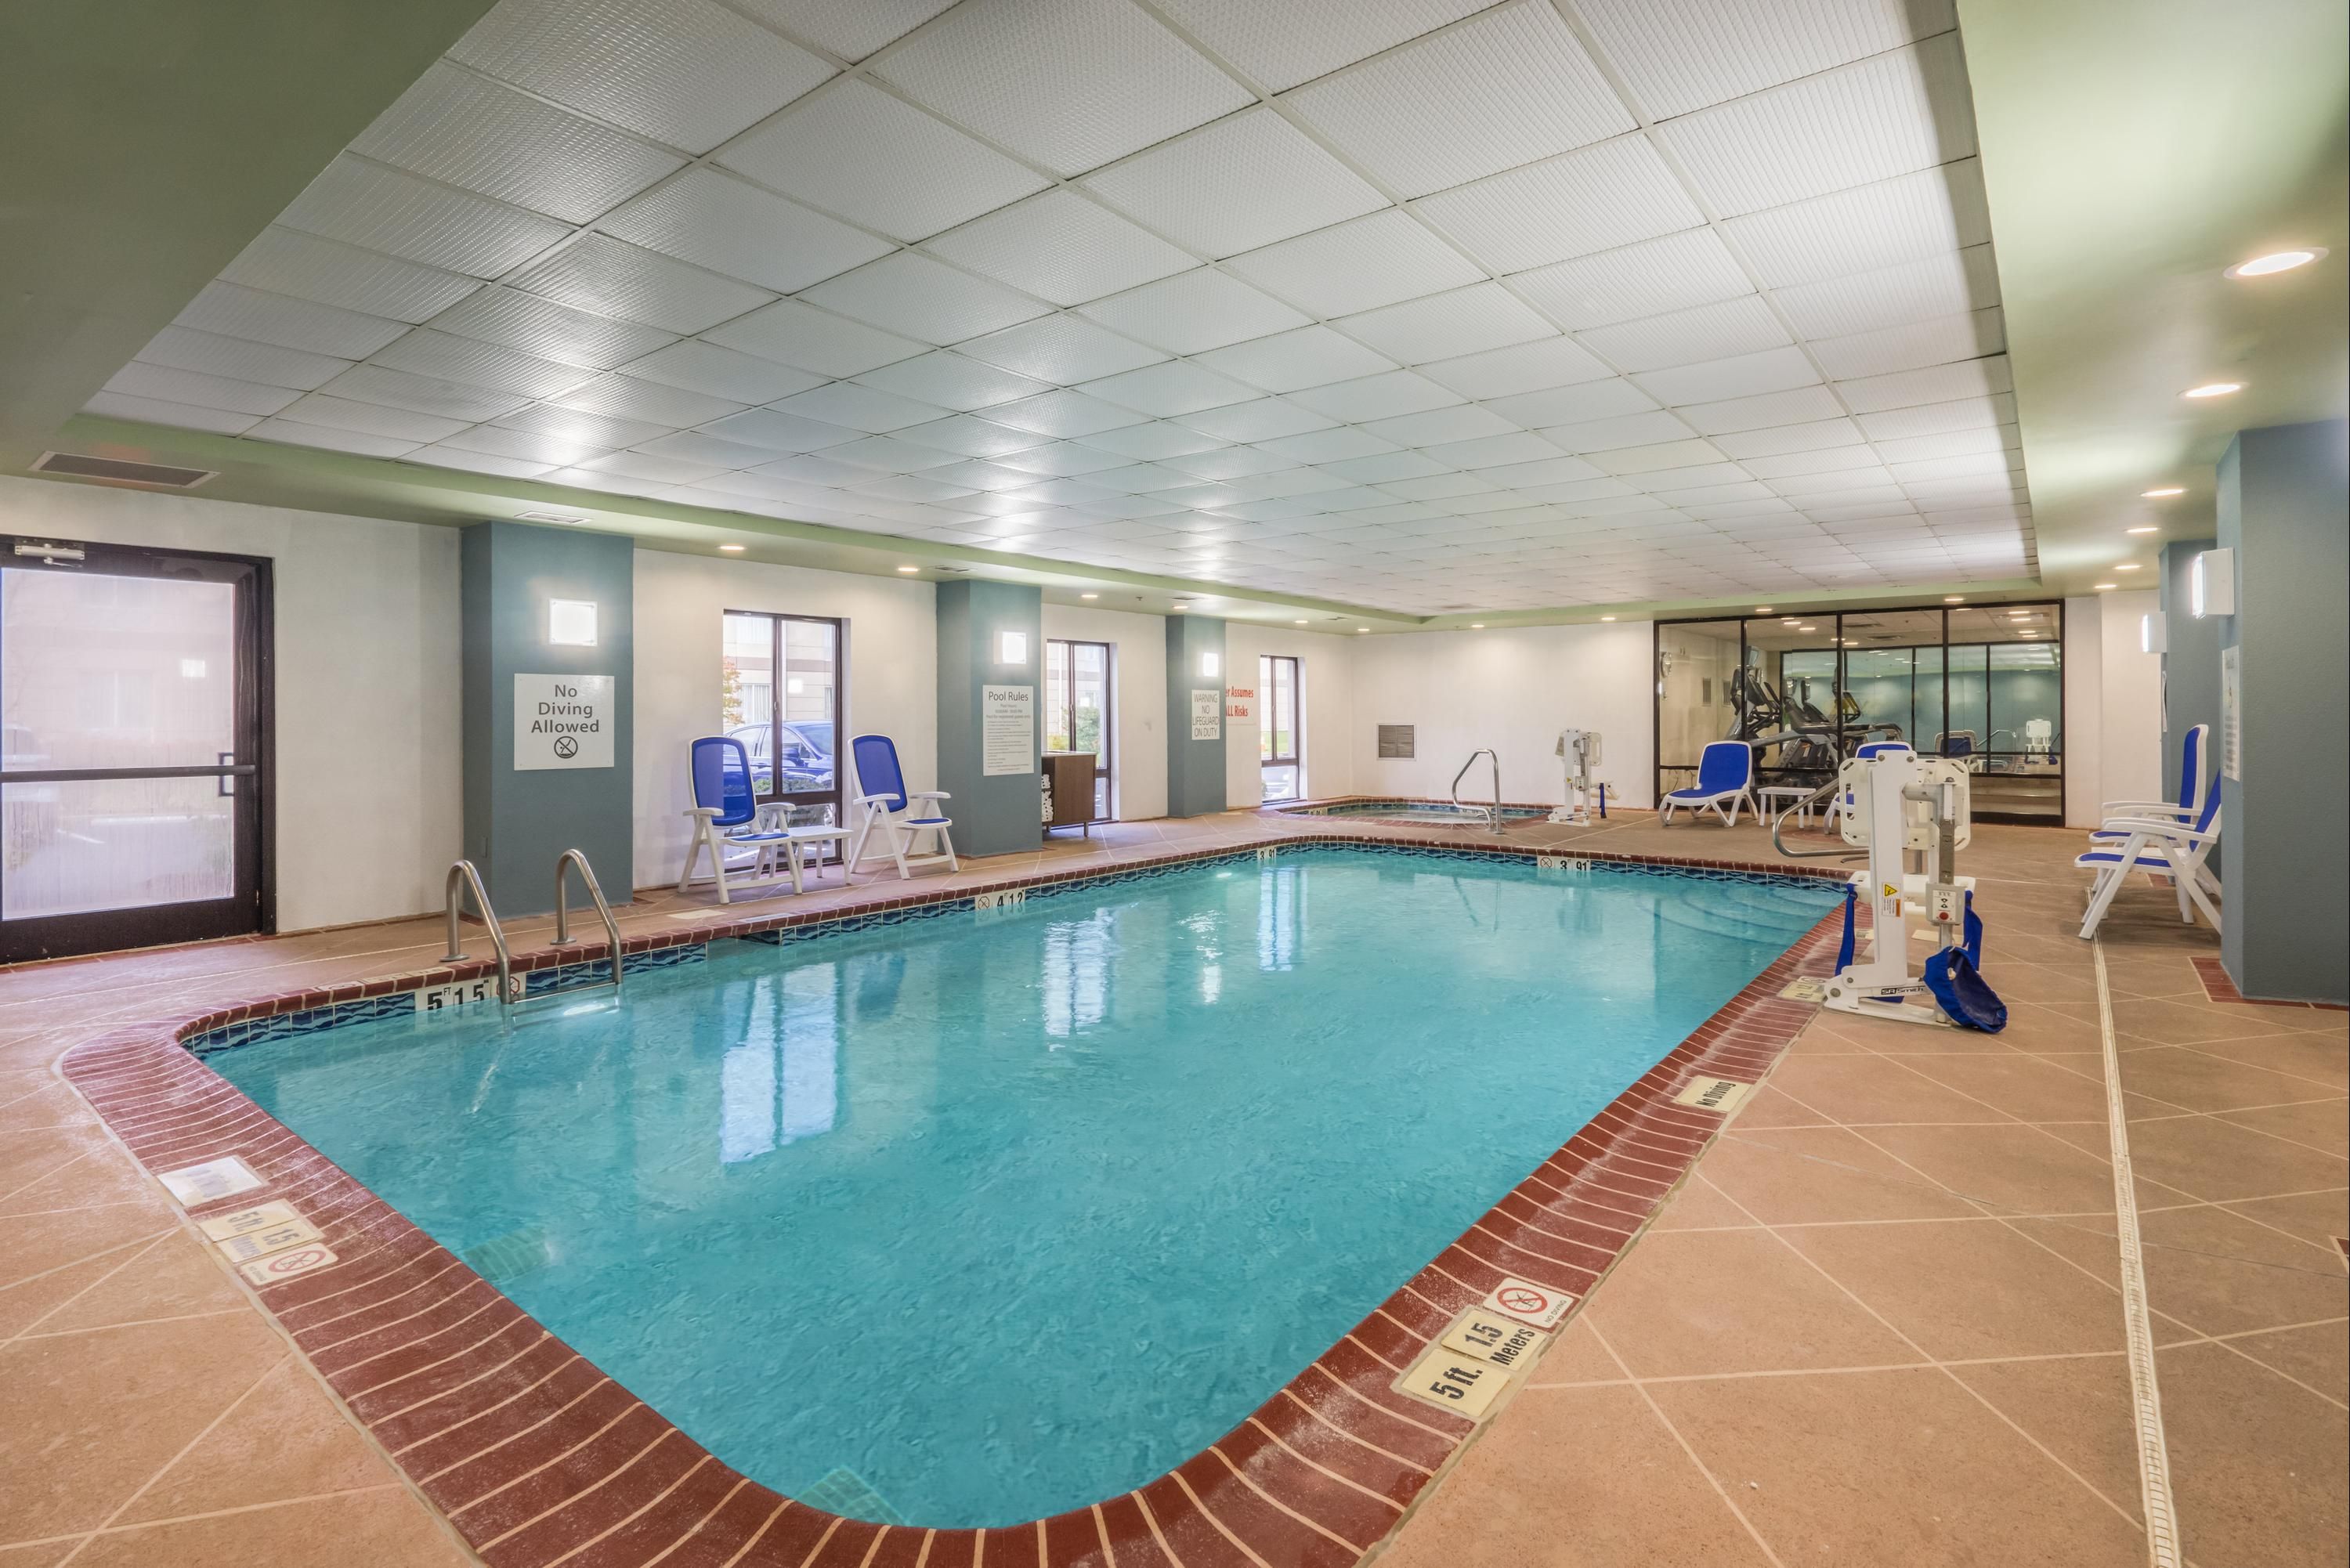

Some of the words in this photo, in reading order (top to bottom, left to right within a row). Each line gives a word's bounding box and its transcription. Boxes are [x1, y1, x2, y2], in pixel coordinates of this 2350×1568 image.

[555, 685, 577, 698] No
[989, 691, 1007, 702] Pool
[1008, 691, 1029, 702] Rules
[1194, 693, 1218, 703] WARNING
[1231, 686, 1254, 698] Assumes
[538, 702, 593, 719] Diving
[1202, 705, 1210, 714] NO
[1235, 705, 1249, 717] Risks
[531, 720, 600, 734] Allowed
[1192, 716, 1220, 726] LIFEGUARD
[1194, 728, 1202, 737] ON
[1203, 727, 1217, 737] DUTY
[427, 992, 443, 1010] 5
[443, 987, 452, 997] FT
[1702, 1082, 1737, 1100] Diving
[1695, 1098, 1719, 1107] No
[1464, 1322, 1503, 1347] 1.5
[1489, 1328, 1535, 1366] Meters
[1443, 1366, 1484, 1386] ft.
[1429, 1382, 1465, 1400] 5
